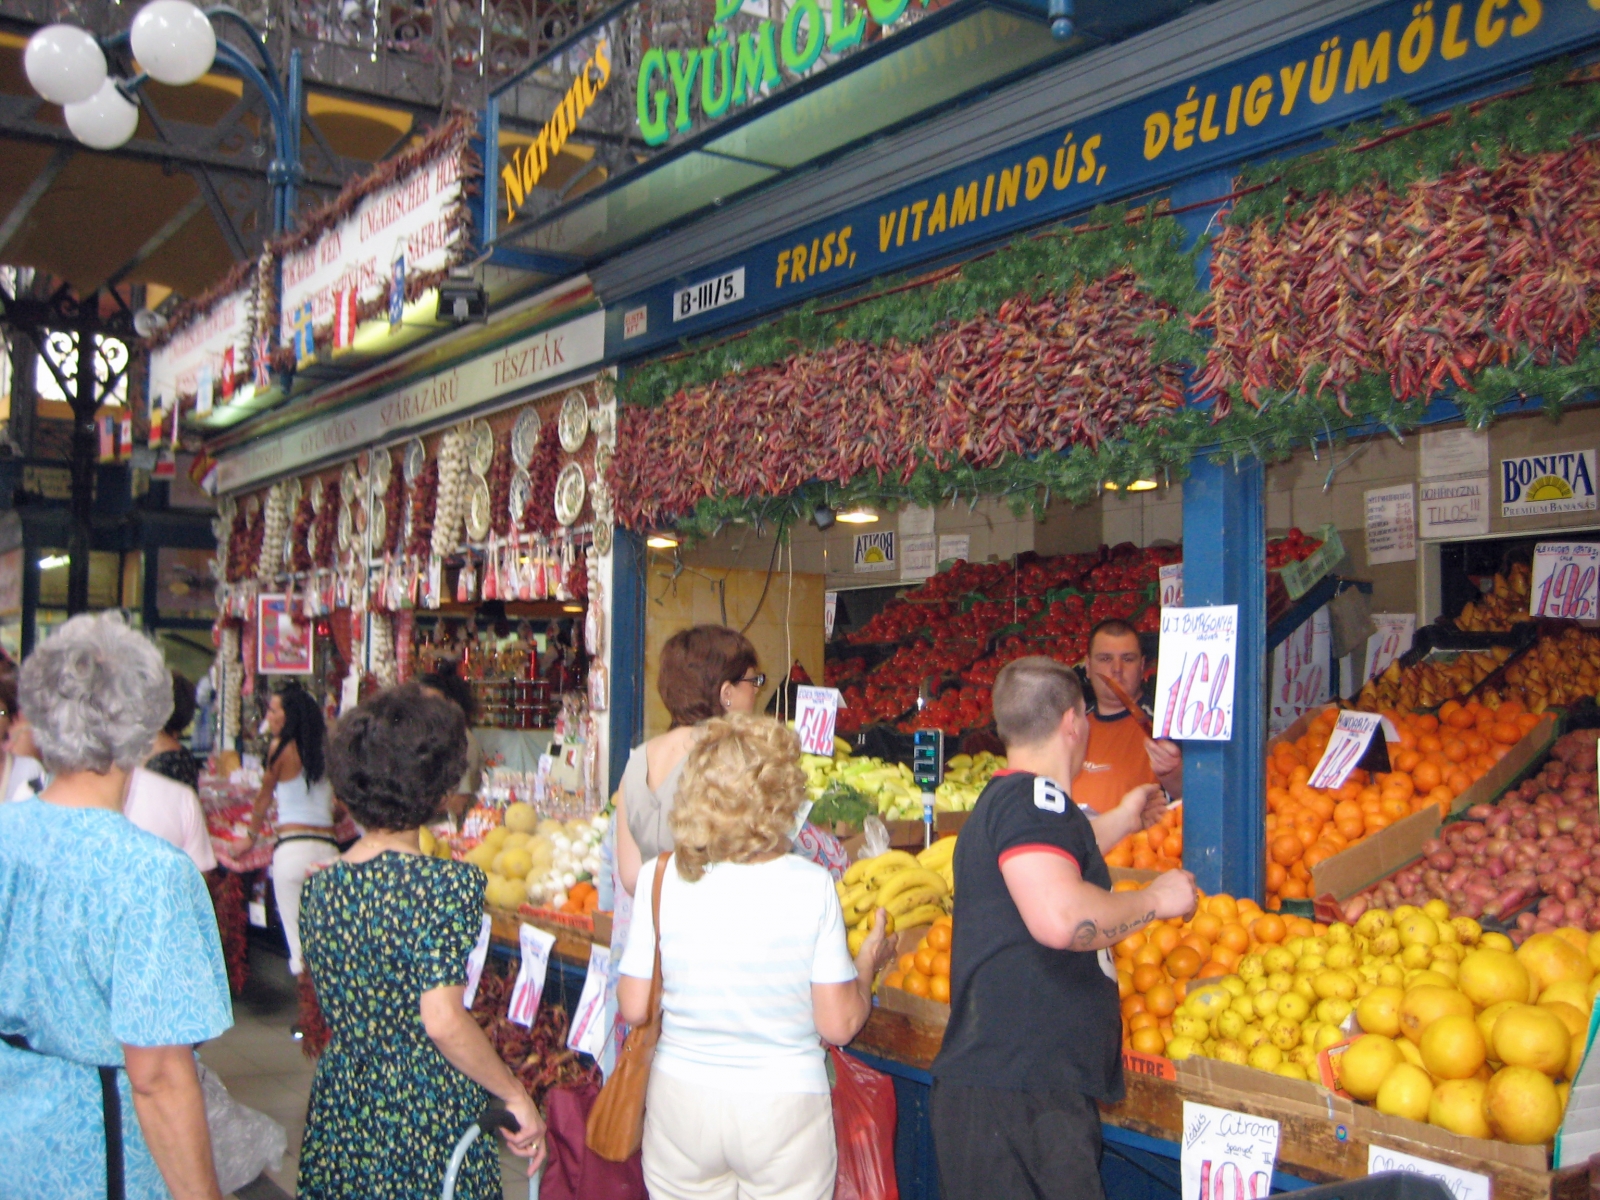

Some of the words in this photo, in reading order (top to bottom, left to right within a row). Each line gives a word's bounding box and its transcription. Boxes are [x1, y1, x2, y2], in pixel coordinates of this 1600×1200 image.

[502, 40, 611, 223] Narancs
[775, 225, 857, 288] FRISS,
[878, 132, 1107, 252] VITAMINDÚS,
[1143, 0, 1543, 161] DÉLIGYÜMÖLCS
[360, 171, 430, 243] UNGARISCHER
[493, 336, 565, 387] TÉSZTÁK
[1502, 452, 1595, 503] BONITA
[1503, 505, 1548, 517] PREMIUM
[1550, 500, 1596, 513] BANANAS
[1182, 612, 1233, 634] BURGONYA
[1157, 650, 1231, 739] 168
[1033, 775, 1066, 814] 6
[1215, 1112, 1278, 1138] Citrom
